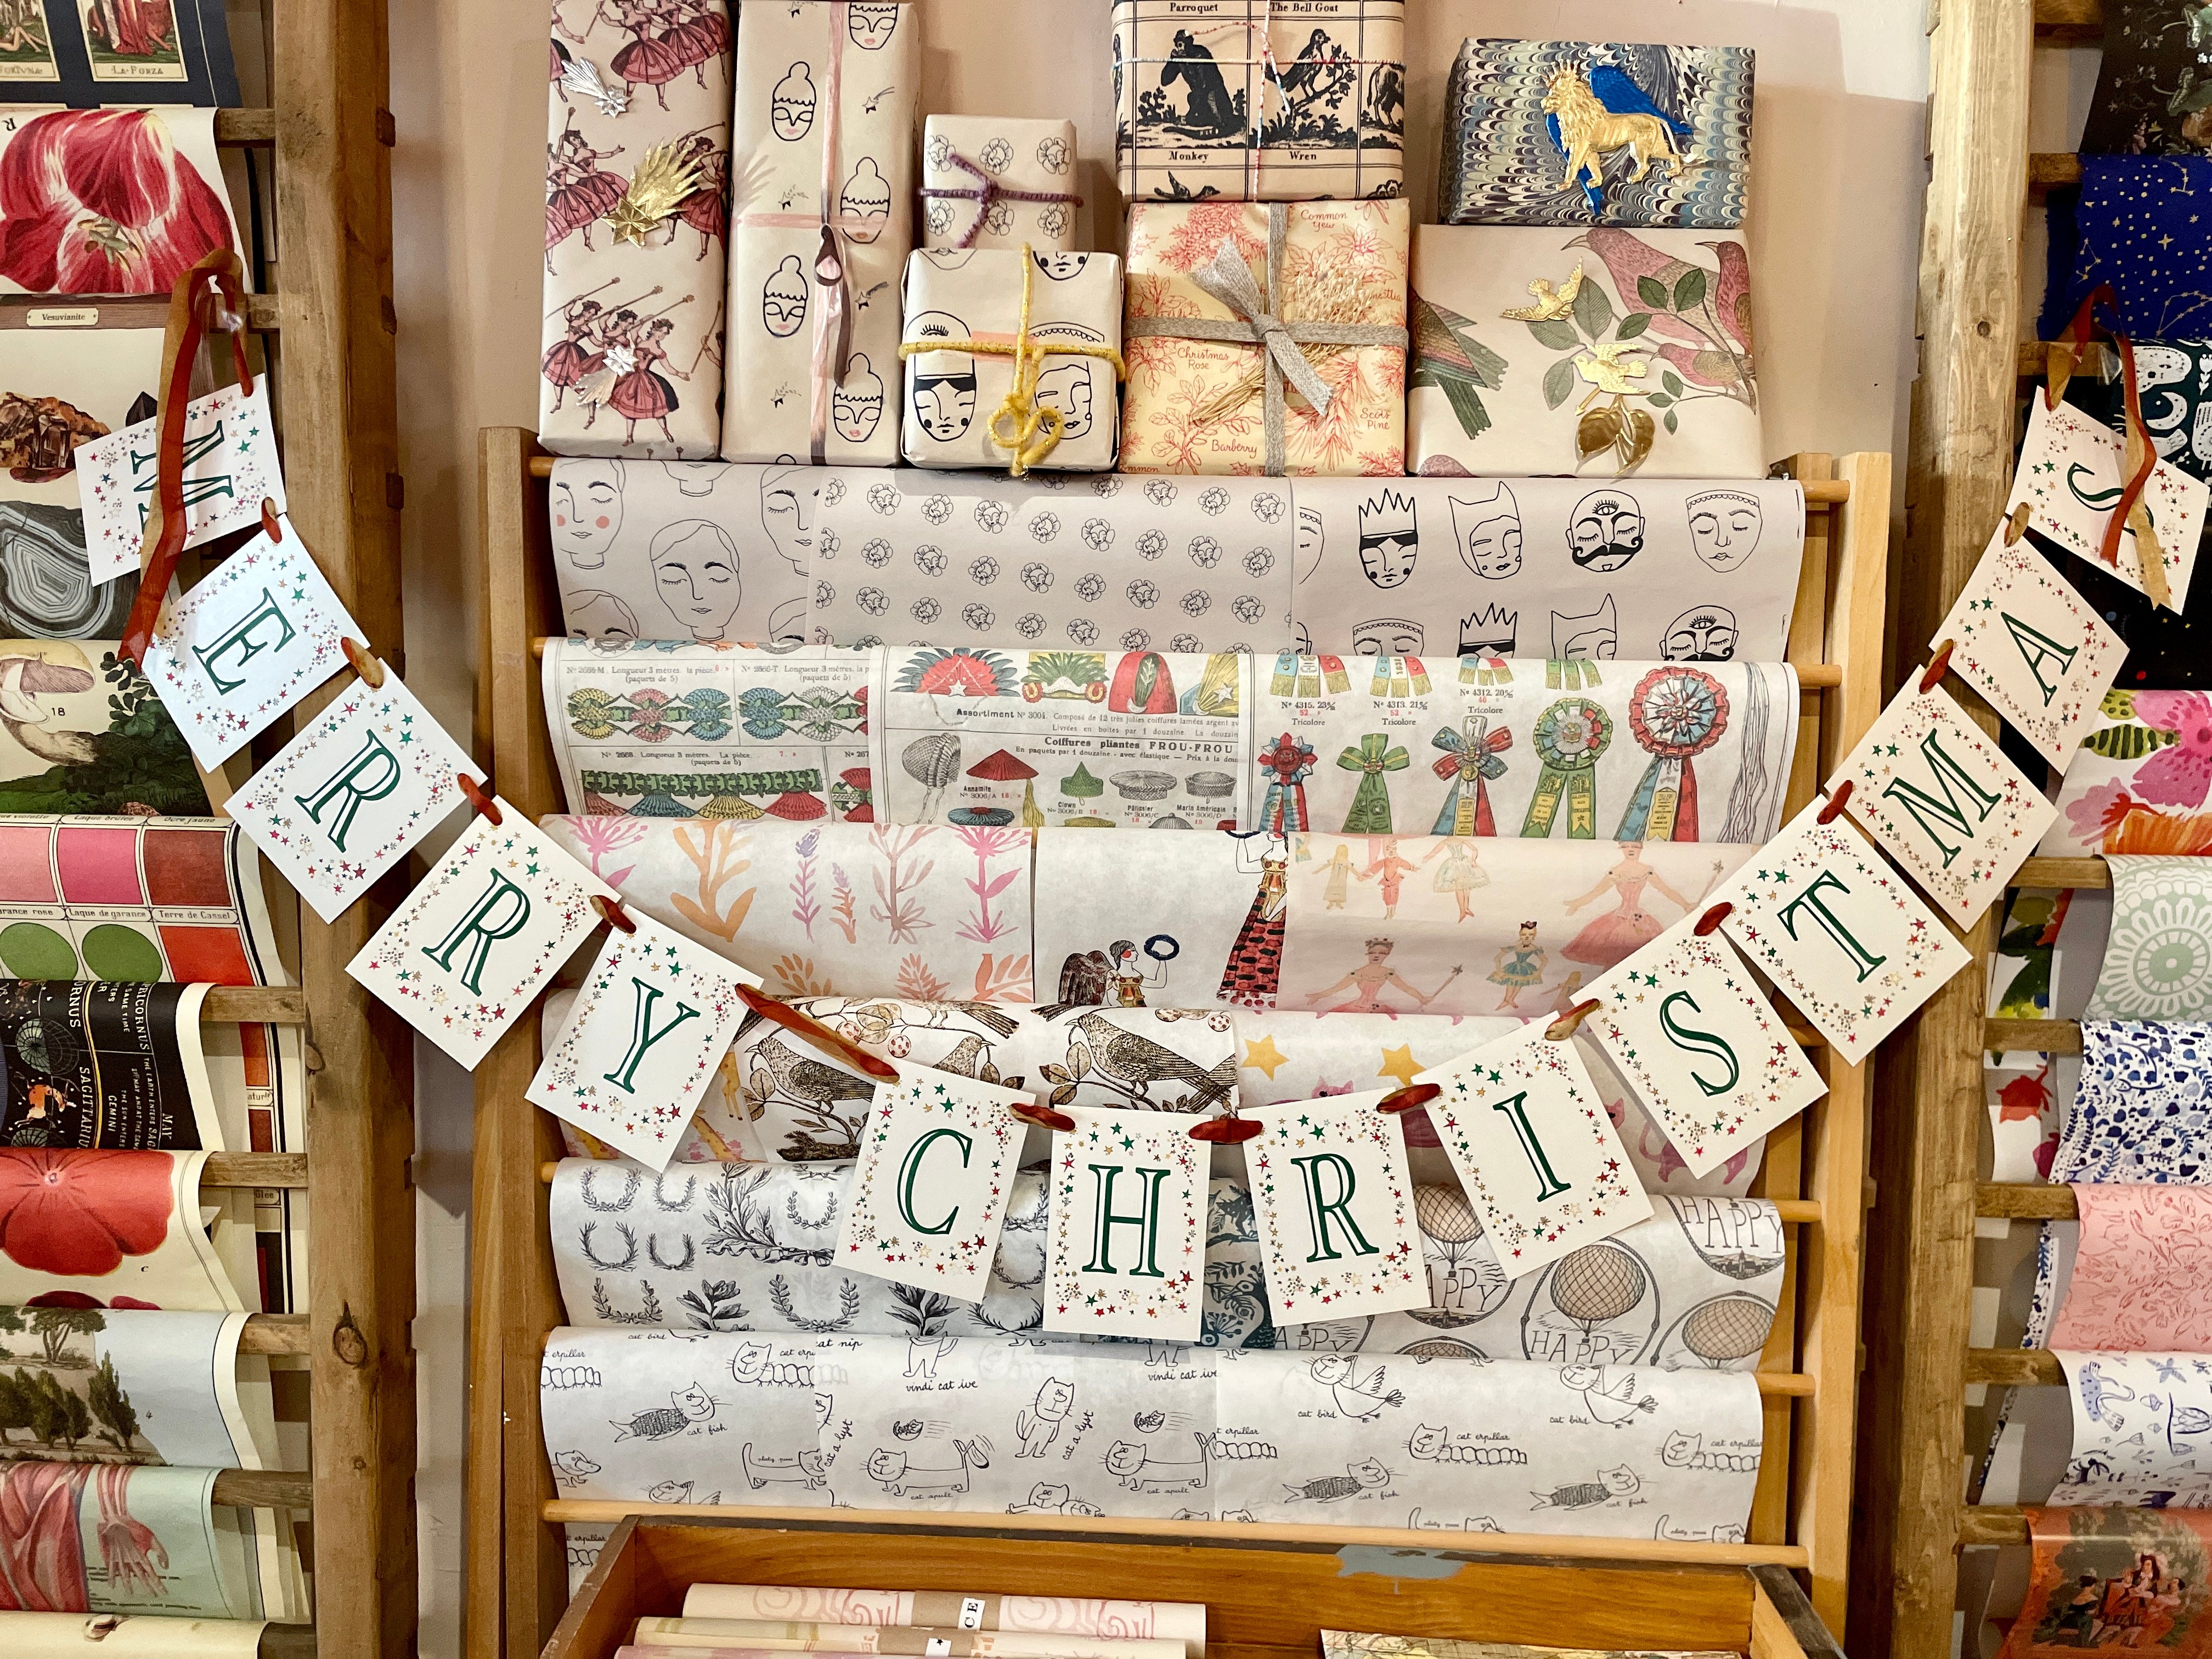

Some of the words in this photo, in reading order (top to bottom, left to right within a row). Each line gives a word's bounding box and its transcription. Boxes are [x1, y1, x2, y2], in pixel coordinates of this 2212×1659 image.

[1169, 2, 1218, 13] Parroquet
[1269, 3, 1288, 13] The
[1292, 1, 1312, 13] Bell
[1315, 3, 1339, 13] Goat
[1169, 151, 1209, 162] Monkey
[1289, 151, 1317, 161] Wren
[1300, 208, 1348, 221] Common
[1312, 219, 1335, 229] Yew
[42, 313, 86, 321] Vesuvianite
[1177, 345, 1229, 361] Christmas
[1188, 359, 1211, 370] Rose
[1359, 408, 1391, 420] Scots
[1367, 419, 1391, 430] Pine
[1211, 439, 1258, 459] Barberry
[612, 666, 646, 675] Longueur
[785, 665, 819, 675] Longueur
[52, 707, 65, 716] 18
[1468, 706, 1503, 714] Tricolore
[956, 708, 1014, 718] Assortiment
[1053, 713, 1085, 721] Composé
[1126, 715, 1145, 724] jolies
[1147, 716, 1177, 724] coiffures
[1180, 716, 1204, 725] lamées
[1206, 718, 1228, 727] argent
[1382, 718, 1417, 726] Tricolore
[1052, 724, 1078, 732] Livrées
[1211, 730, 1238, 738] douzain
[1045, 736, 1091, 747] Coiffures
[1099, 739, 1140, 749] pliantes
[1149, 741, 1233, 754] FROU-FROU
[641, 752, 675, 760] Longueur
[1029, 747, 1056, 756] paquets
[1139, 751, 1170, 760] élastique
[1186, 753, 1201, 761] Prix
[69, 909, 95, 918] Laque
[110, 911, 146, 920] garance
[159, 910, 184, 918] Terre
[200, 911, 231, 919] Cassel
[121, 988, 133, 1009] SAME
[122, 1012, 131, 1033] TIME
[135, 982, 150, 1051] PRICORNUS
[78, 1066, 94, 1149] SAGITTARIU
[108, 1094, 117, 1132] GEMINI
[161, 1113, 174, 1141] MAY
[1683, 1196, 1784, 1254] HAPPY
[1425, 1267, 1503, 1313] APPY
[816, 1339, 834, 1348] at
[838, 1338, 863, 1351] nip
[551, 1349, 586, 1363] erpillar
[1148, 1370, 1176, 1382] vindi
[1180, 1370, 1198, 1380] cat
[906, 1382, 934, 1392] vindi
[938, 1381, 956, 1391] cat
[959, 1378, 979, 1389] ive
[1317, 1409, 1338, 1419] bird
[1569, 1414, 1590, 1425] bird
[709, 1423, 727, 1436] fish
[1225, 1426, 1260, 1437] erpillar
[1475, 1432, 1511, 1443] erpillar
[1062, 1445, 1077, 1462] cat
[1073, 1435, 1081, 1446] a
[825, 1452, 836, 1468] cat
[833, 1444, 841, 1453] a
[928, 1491, 953, 1500] apult
[1164, 1486, 1190, 1495] apult
